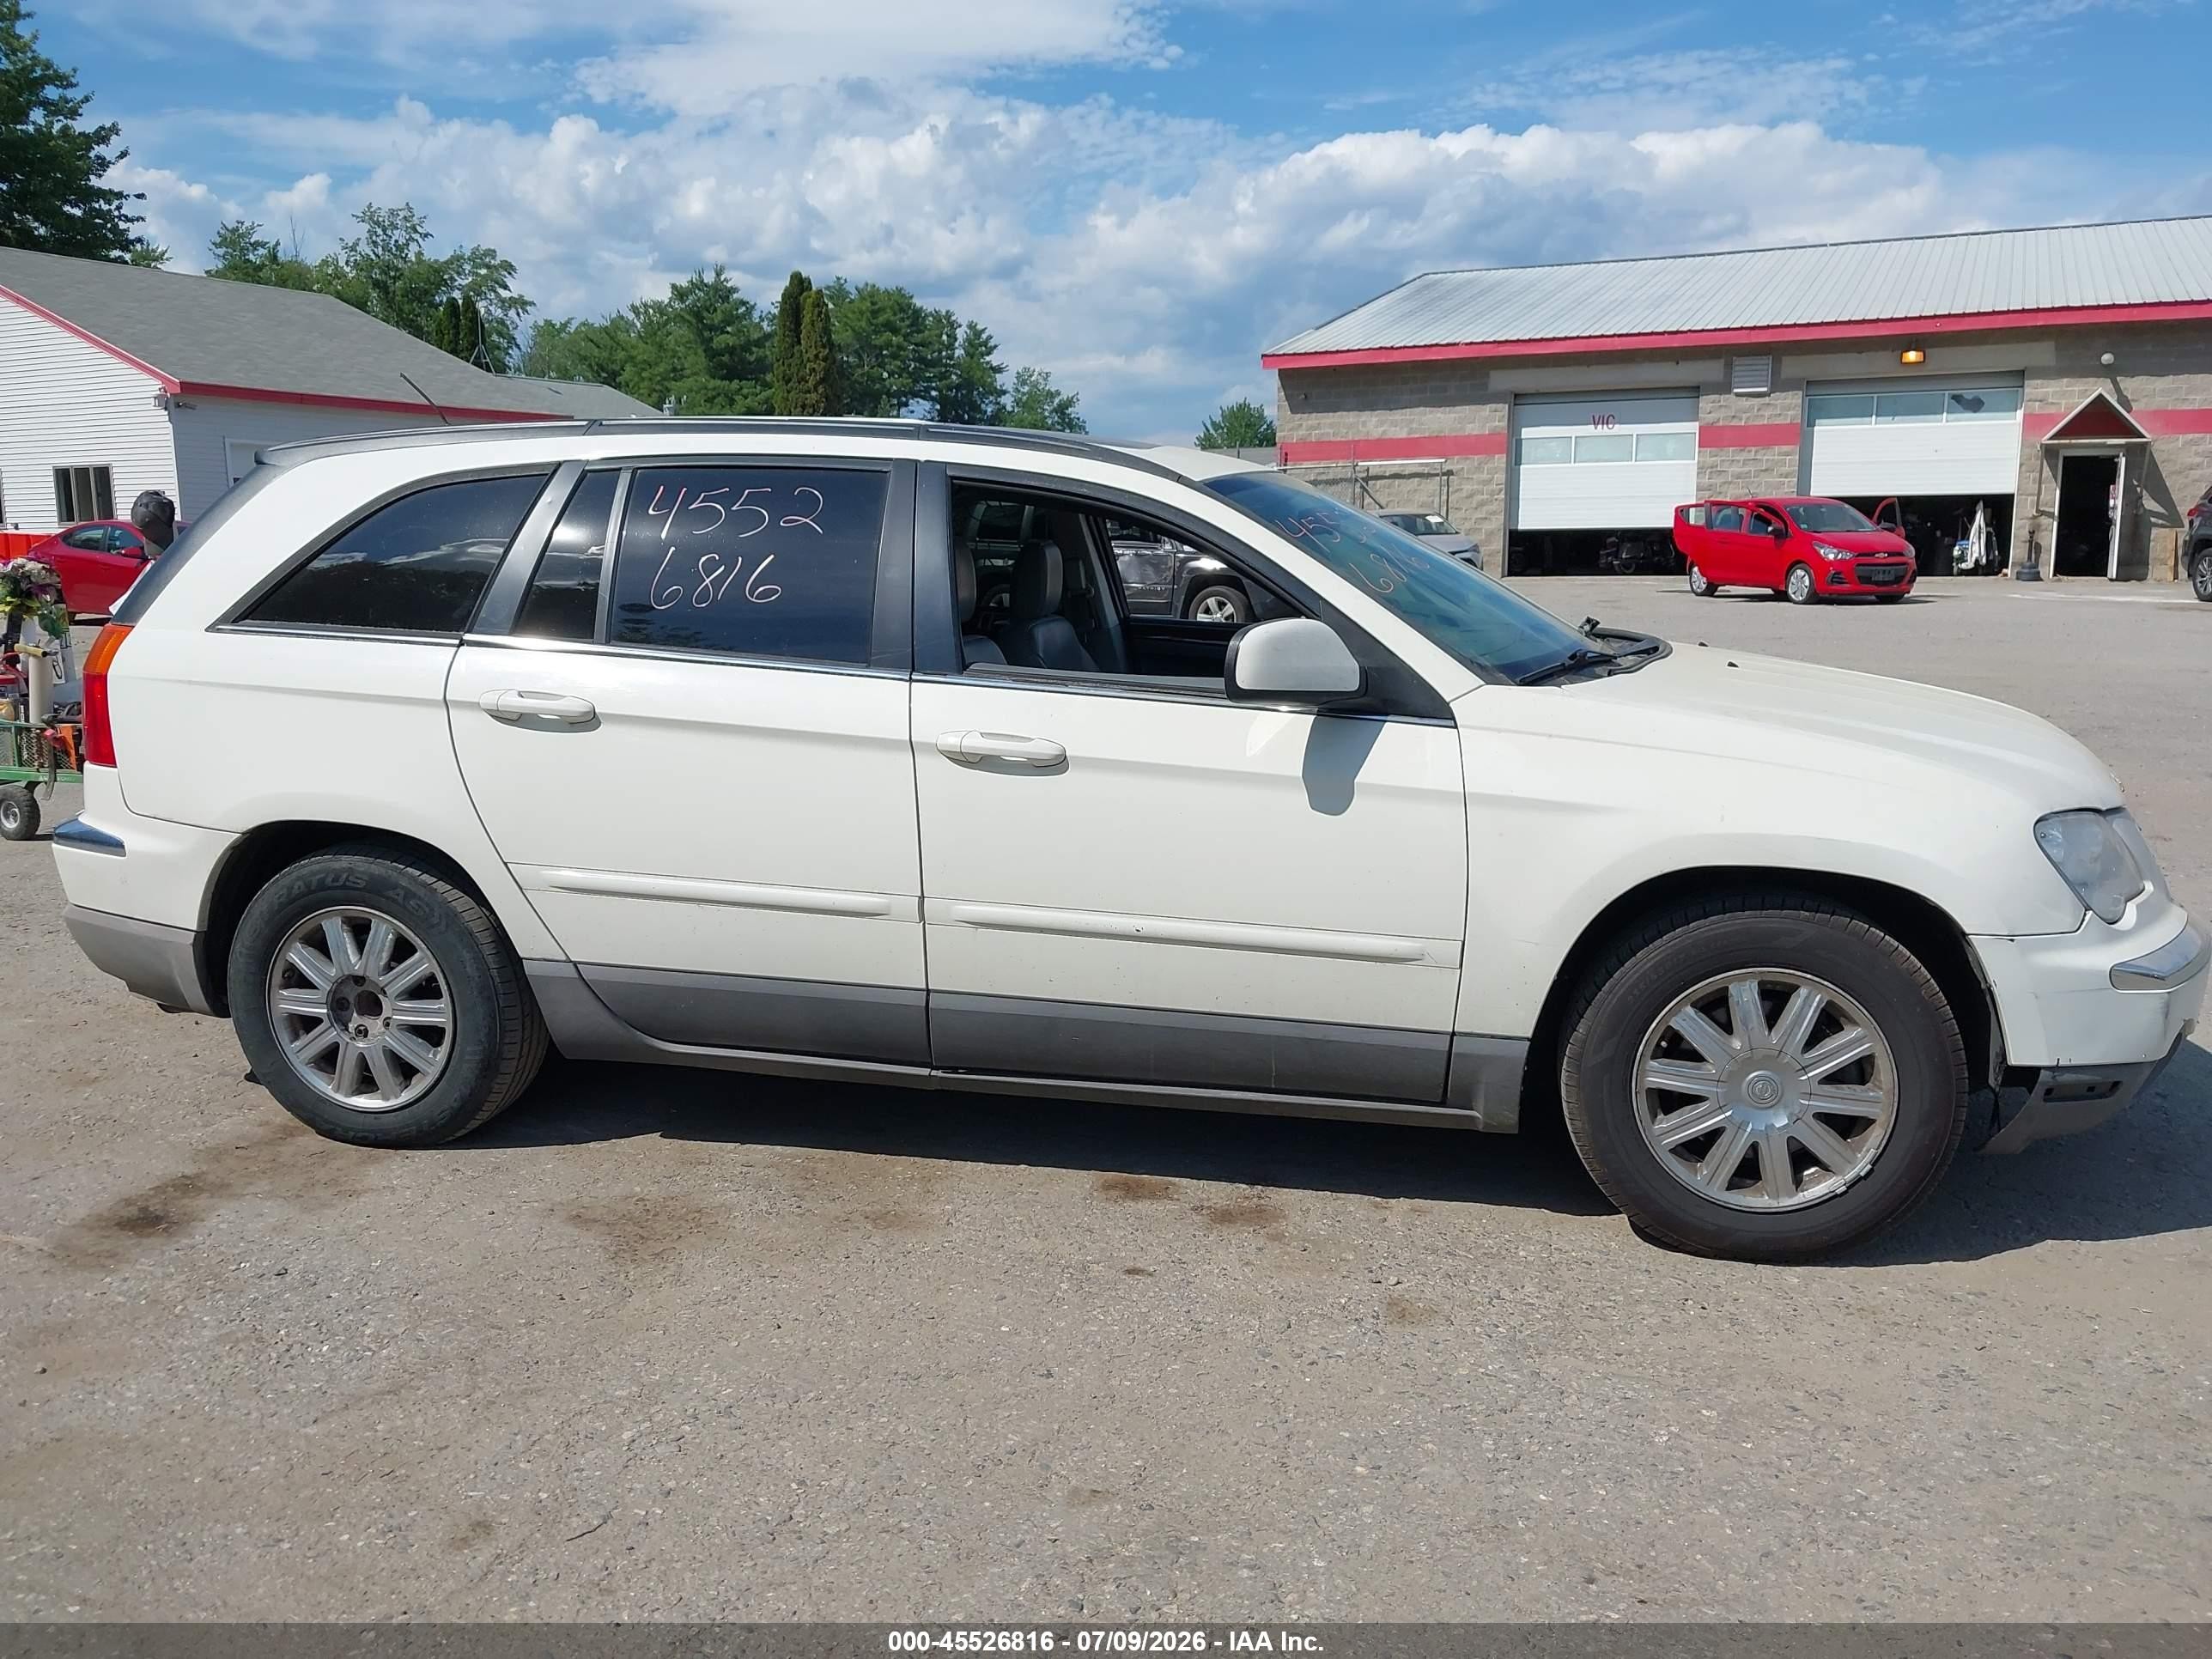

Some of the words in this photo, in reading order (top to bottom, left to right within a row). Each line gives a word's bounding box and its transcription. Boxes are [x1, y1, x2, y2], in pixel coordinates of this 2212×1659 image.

[1592, 414, 1615, 430] VIC
[647, 485, 823, 540] 4552
[650, 546, 782, 610] 6816
